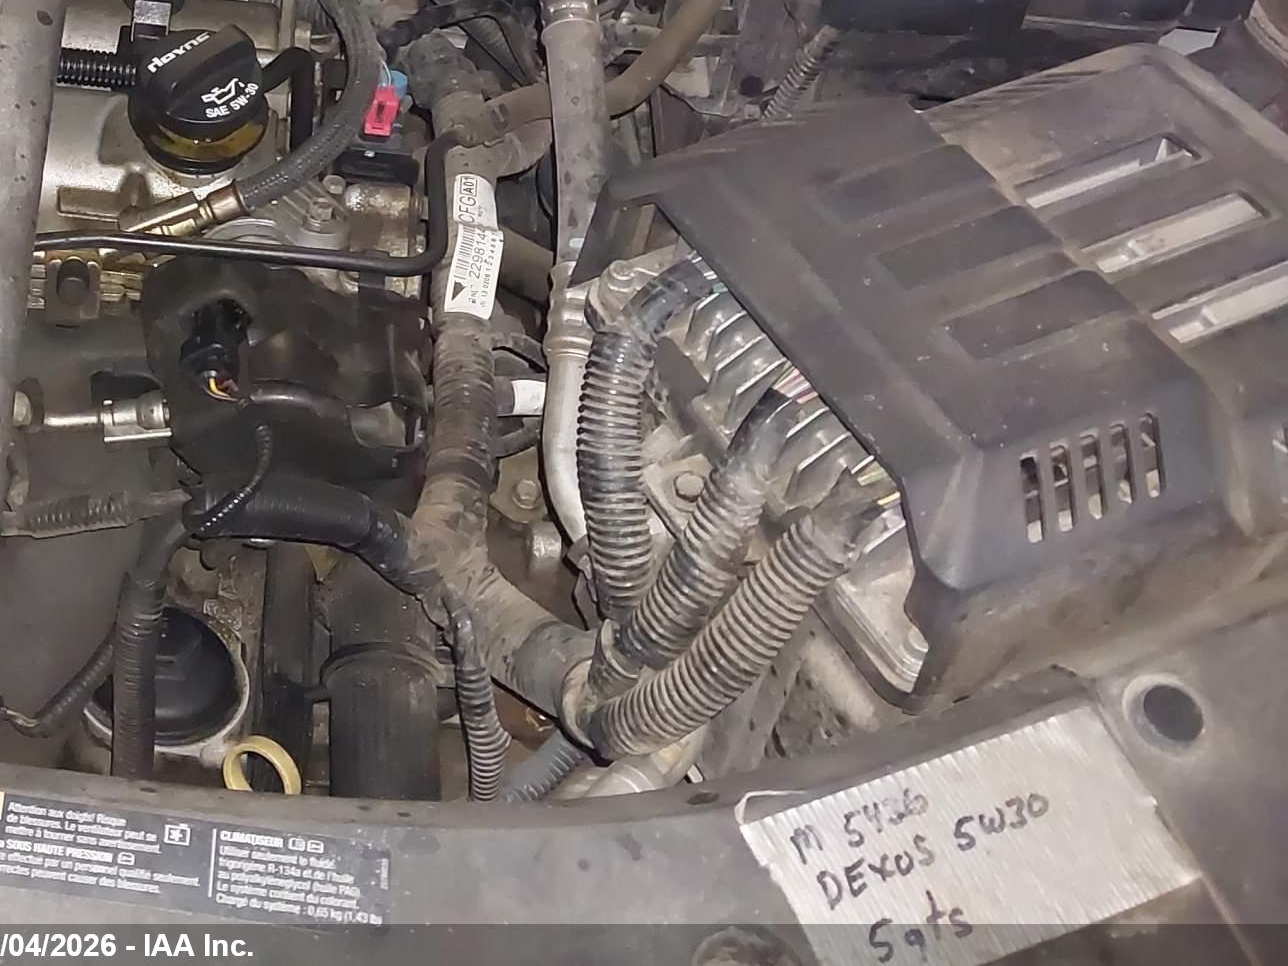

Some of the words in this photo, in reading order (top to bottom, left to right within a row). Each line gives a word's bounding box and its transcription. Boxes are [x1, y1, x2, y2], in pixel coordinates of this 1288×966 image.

[205, 105, 230, 118] SAE
[230, 83, 260, 111] 5W-30
[463, 176, 476, 194] A01
[458, 195, 478, 227] CFG
[8, 802, 47, 816] Attention
[6, 813, 19, 823] de
[64, 820, 76, 832] Le
[124, 830, 145, 841] peut
[220, 831, 284, 848] CLIMATISEUR
[6, 839, 32, 852] SOUS
[33, 843, 65, 856] HAUTE
[65, 847, 113, 862] PRESSION
[98, 876, 116, 888] des
[816, 835, 937, 911] DEXOS
[216, 881, 229, 892] Le
